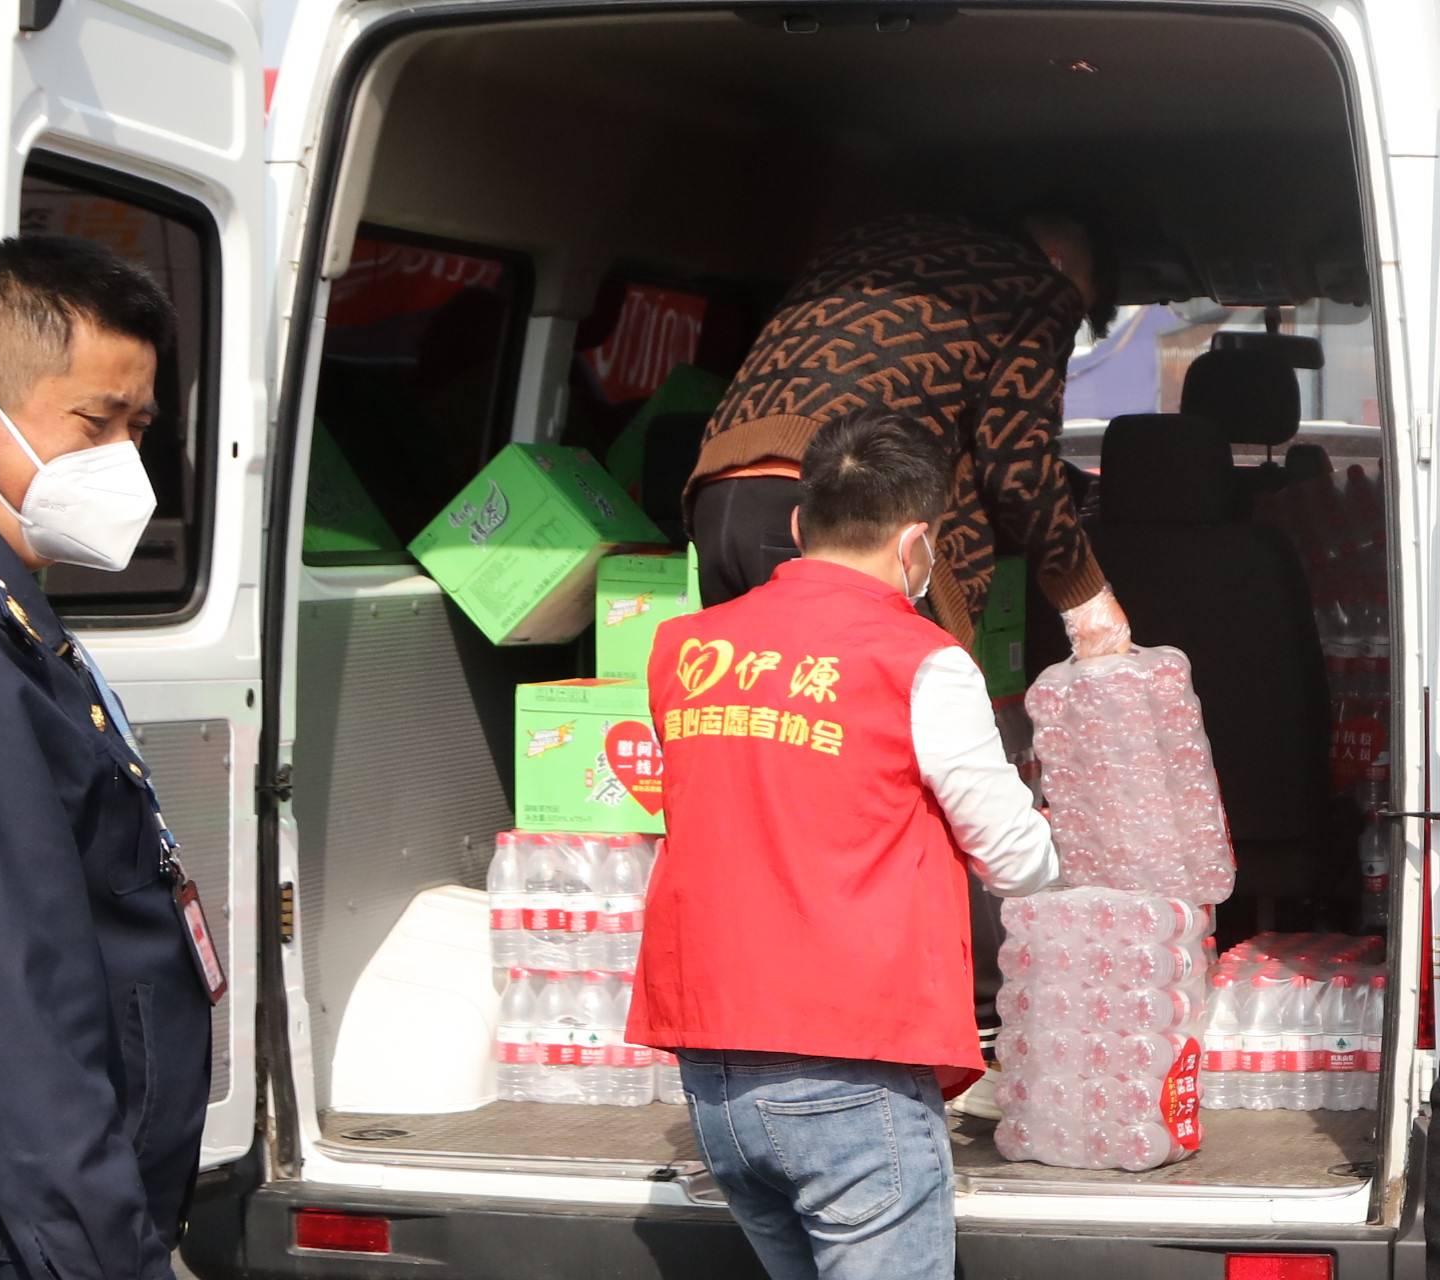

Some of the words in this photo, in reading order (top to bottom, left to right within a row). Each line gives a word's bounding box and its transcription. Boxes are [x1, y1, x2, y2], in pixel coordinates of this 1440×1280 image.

[664, 704, 844, 757] 爱心志愿者协会
